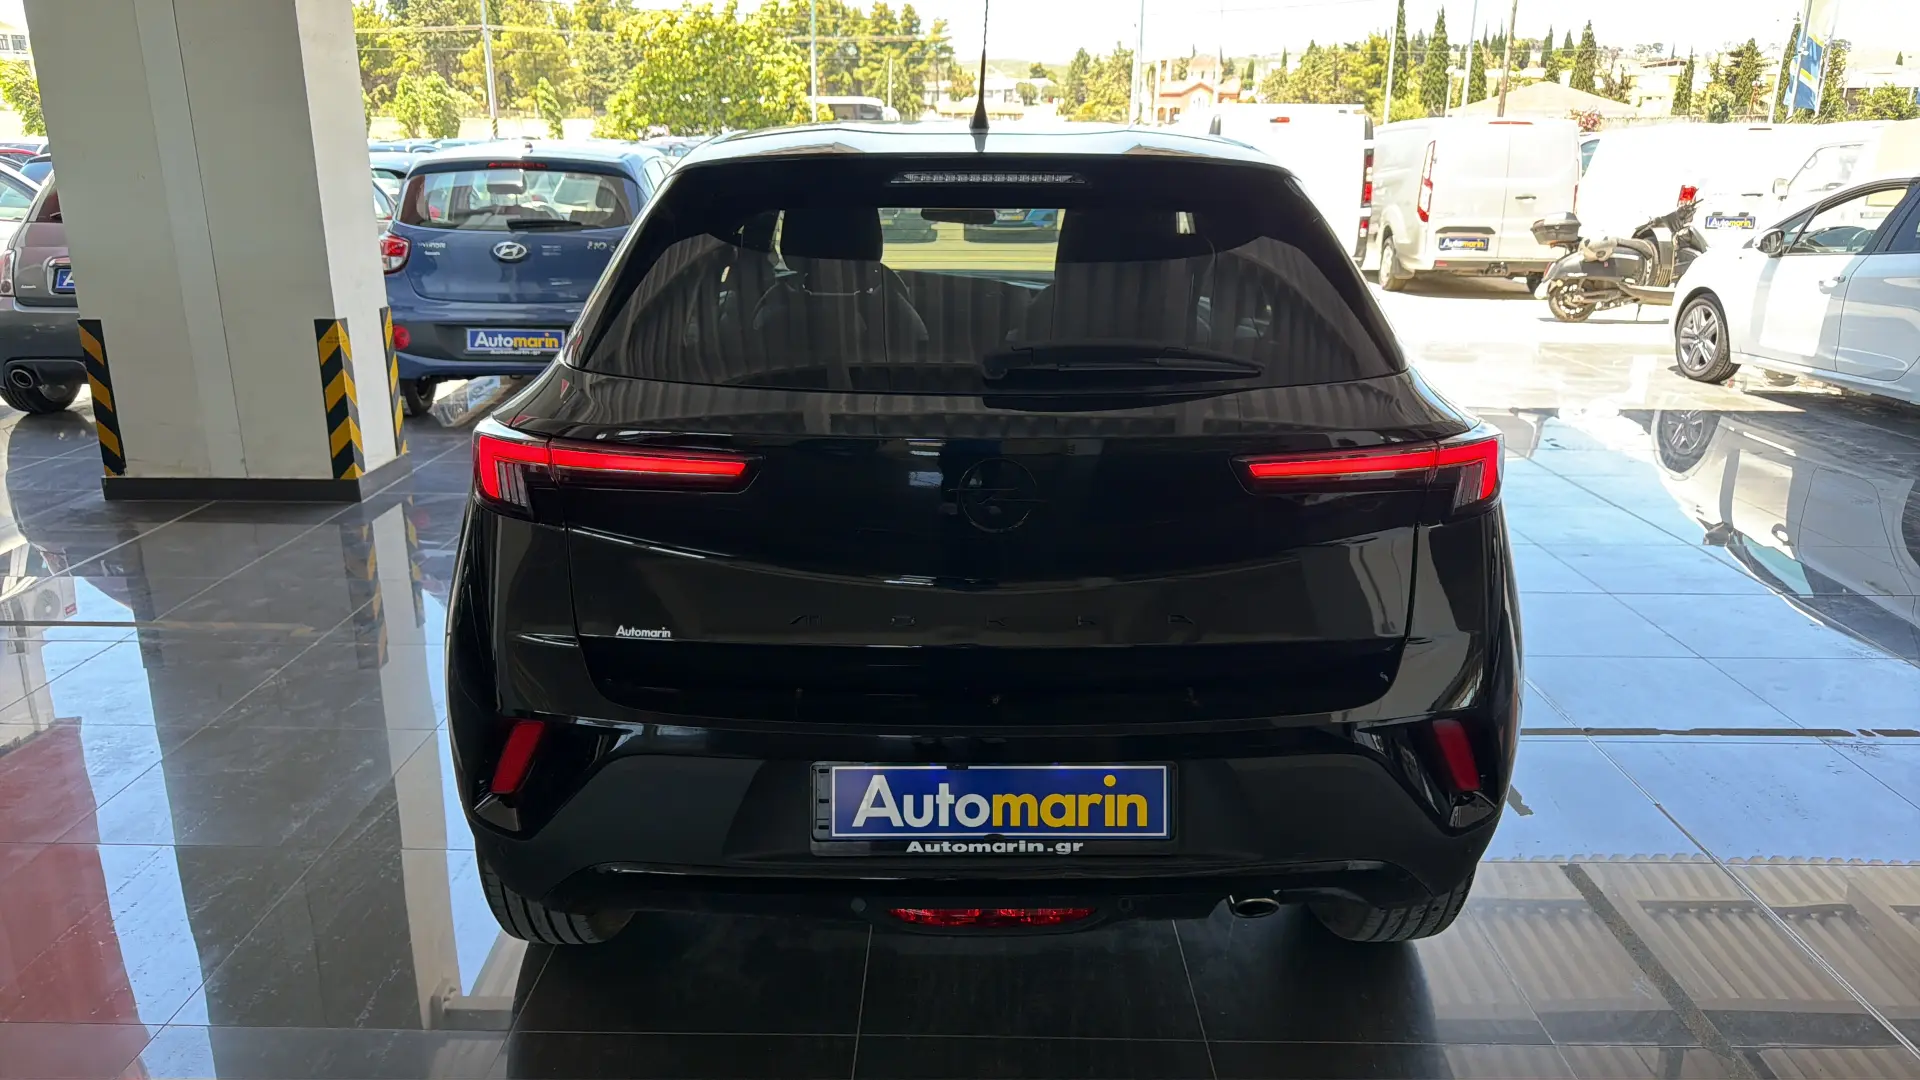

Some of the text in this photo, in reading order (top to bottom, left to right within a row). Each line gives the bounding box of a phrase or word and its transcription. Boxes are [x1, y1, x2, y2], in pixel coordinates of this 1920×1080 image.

[474, 331, 559, 348] Automarin
[615, 624, 671, 638] Automarin
[852, 774, 1148, 828] Automarin
[905, 840, 1084, 855] Automarin.gr
